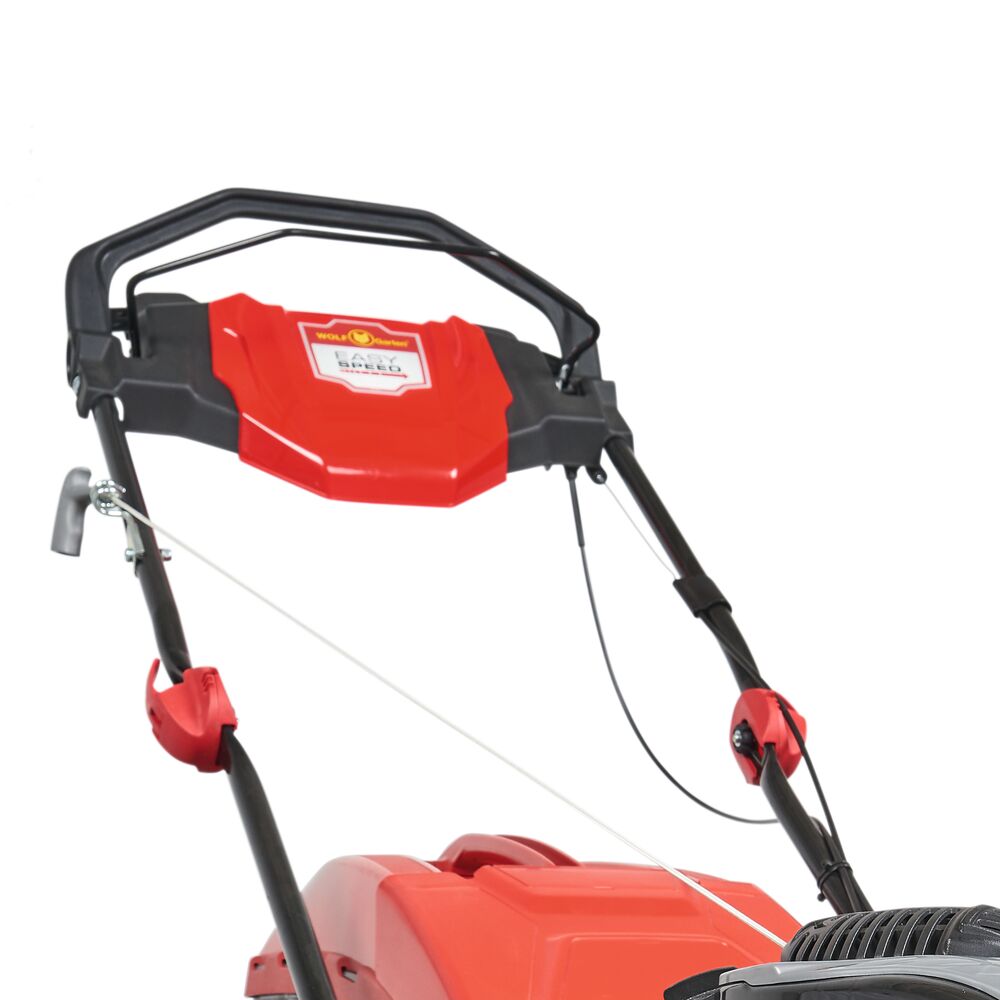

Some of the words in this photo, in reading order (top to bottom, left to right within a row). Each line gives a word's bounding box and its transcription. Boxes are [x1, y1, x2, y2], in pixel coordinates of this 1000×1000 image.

[315, 332, 347, 341] WOLF
[334, 351, 397, 363] EASY
[338, 361, 402, 372] SPEED
